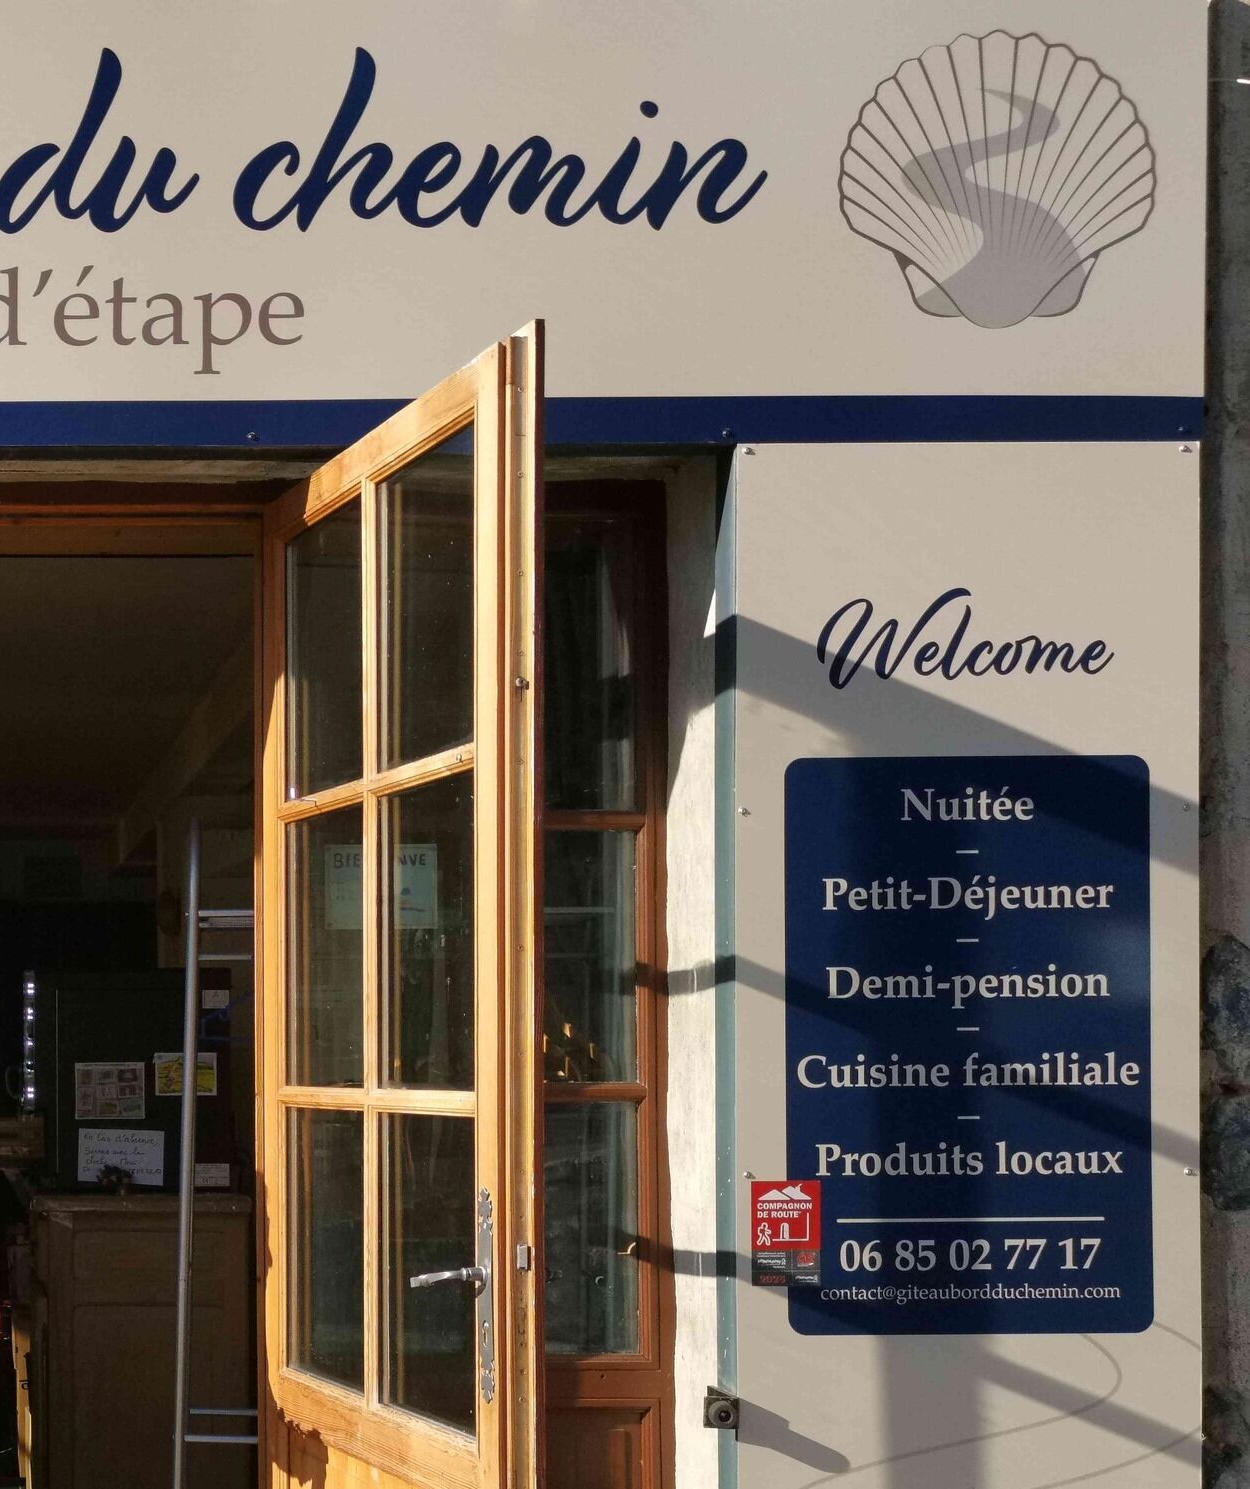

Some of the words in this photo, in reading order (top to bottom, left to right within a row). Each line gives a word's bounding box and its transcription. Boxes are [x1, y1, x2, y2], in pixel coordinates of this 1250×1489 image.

[233, 46, 768, 233] chemin
[816, 587, 1115, 690] Welcome
[900, 786, 1035, 821] Nuitée
[821, 875, 1114, 921] Petit-Déjeuner
[825, 963, 1111, 1009] Demi-pension
[796, 1053, 950, 1089] Cuisine
[963, 1052, 1140, 1087] familiale
[815, 1142, 984, 1177] Produits
[995, 1140, 1124, 1175] locaux
[757, 1202, 813, 1210] COMPAGNON
[771, 1210, 800, 1218] ROUTE
[839, 1239, 883, 1271] 06
[895, 1239, 937, 1271] 85
[949, 1239, 992, 1271] 02
[1004, 1238, 1047, 1270] 77
[1057, 1238, 1102, 1270] 17
[820, 1282, 1121, 1305] contact@giteaubordduchemin.com
